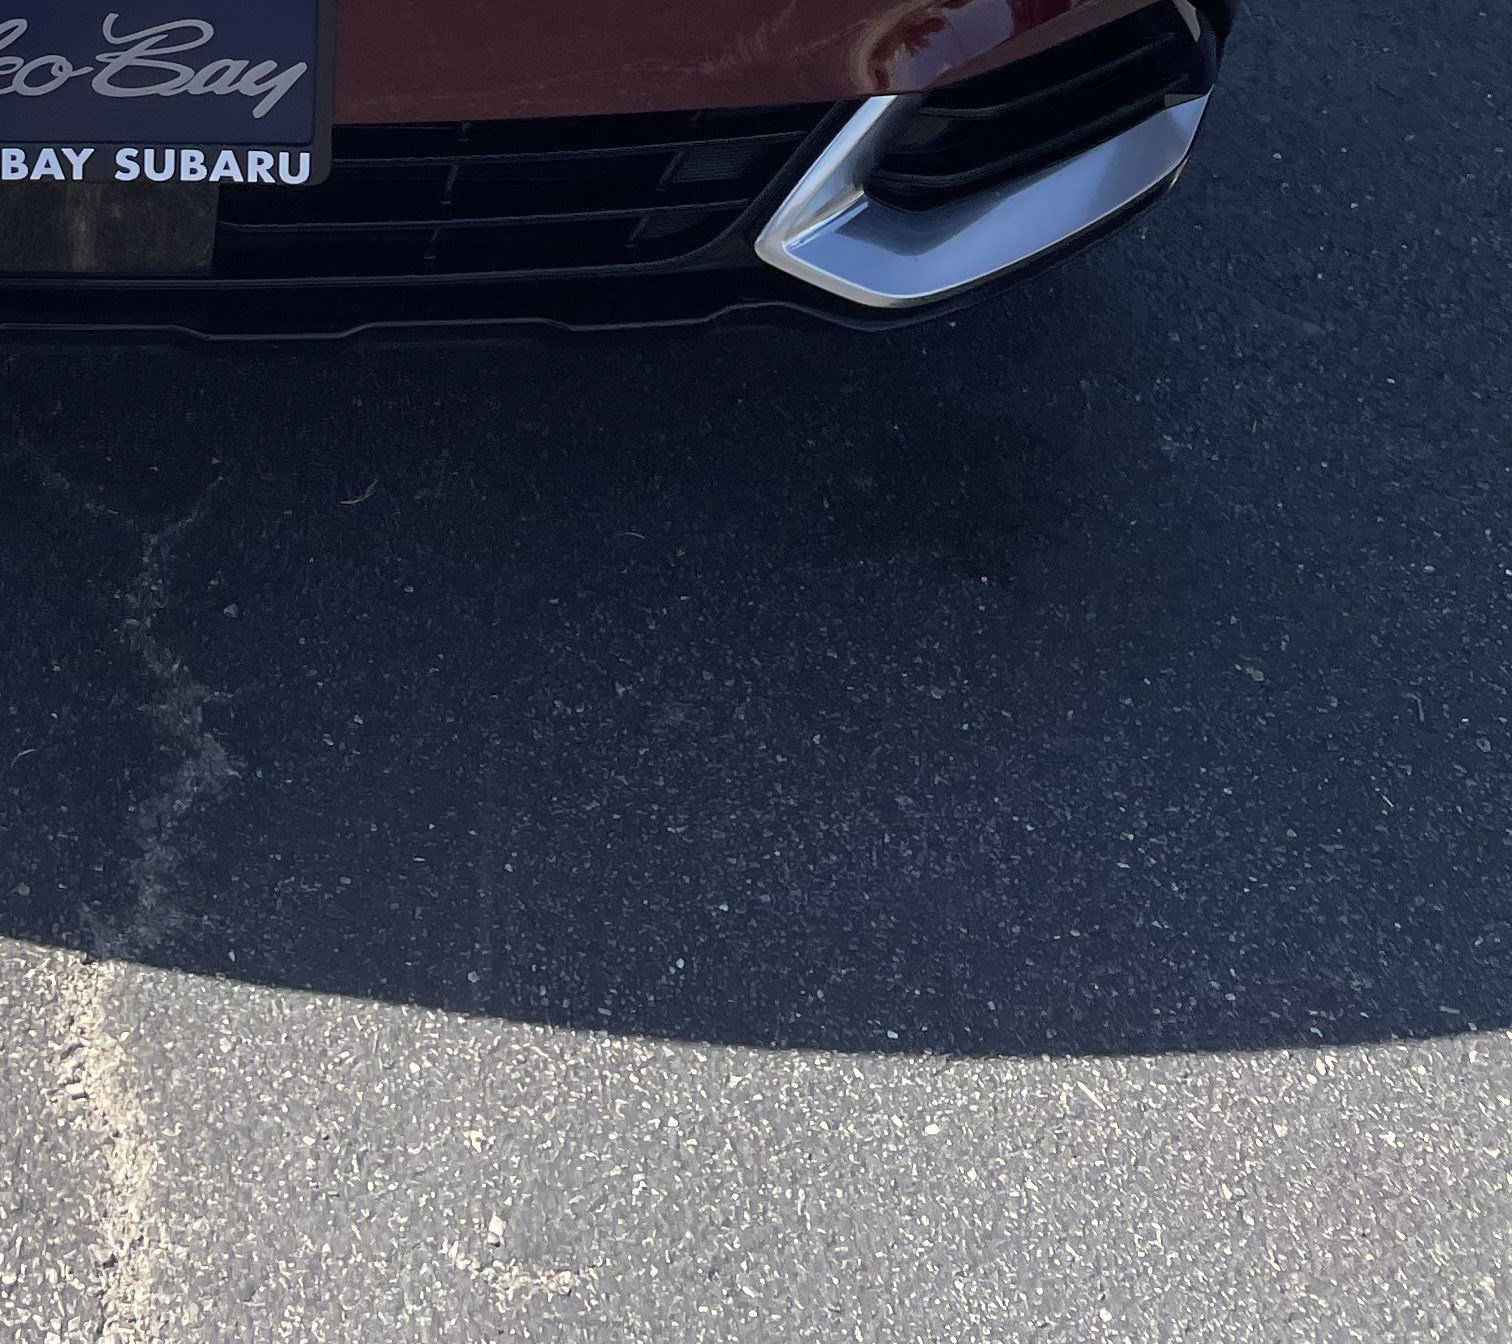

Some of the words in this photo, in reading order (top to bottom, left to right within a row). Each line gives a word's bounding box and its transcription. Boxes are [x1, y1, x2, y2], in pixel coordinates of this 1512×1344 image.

[91, 12, 308, 119] Bay
[1, 147, 95, 182] BAY
[114, 148, 311, 185] SUBARU
